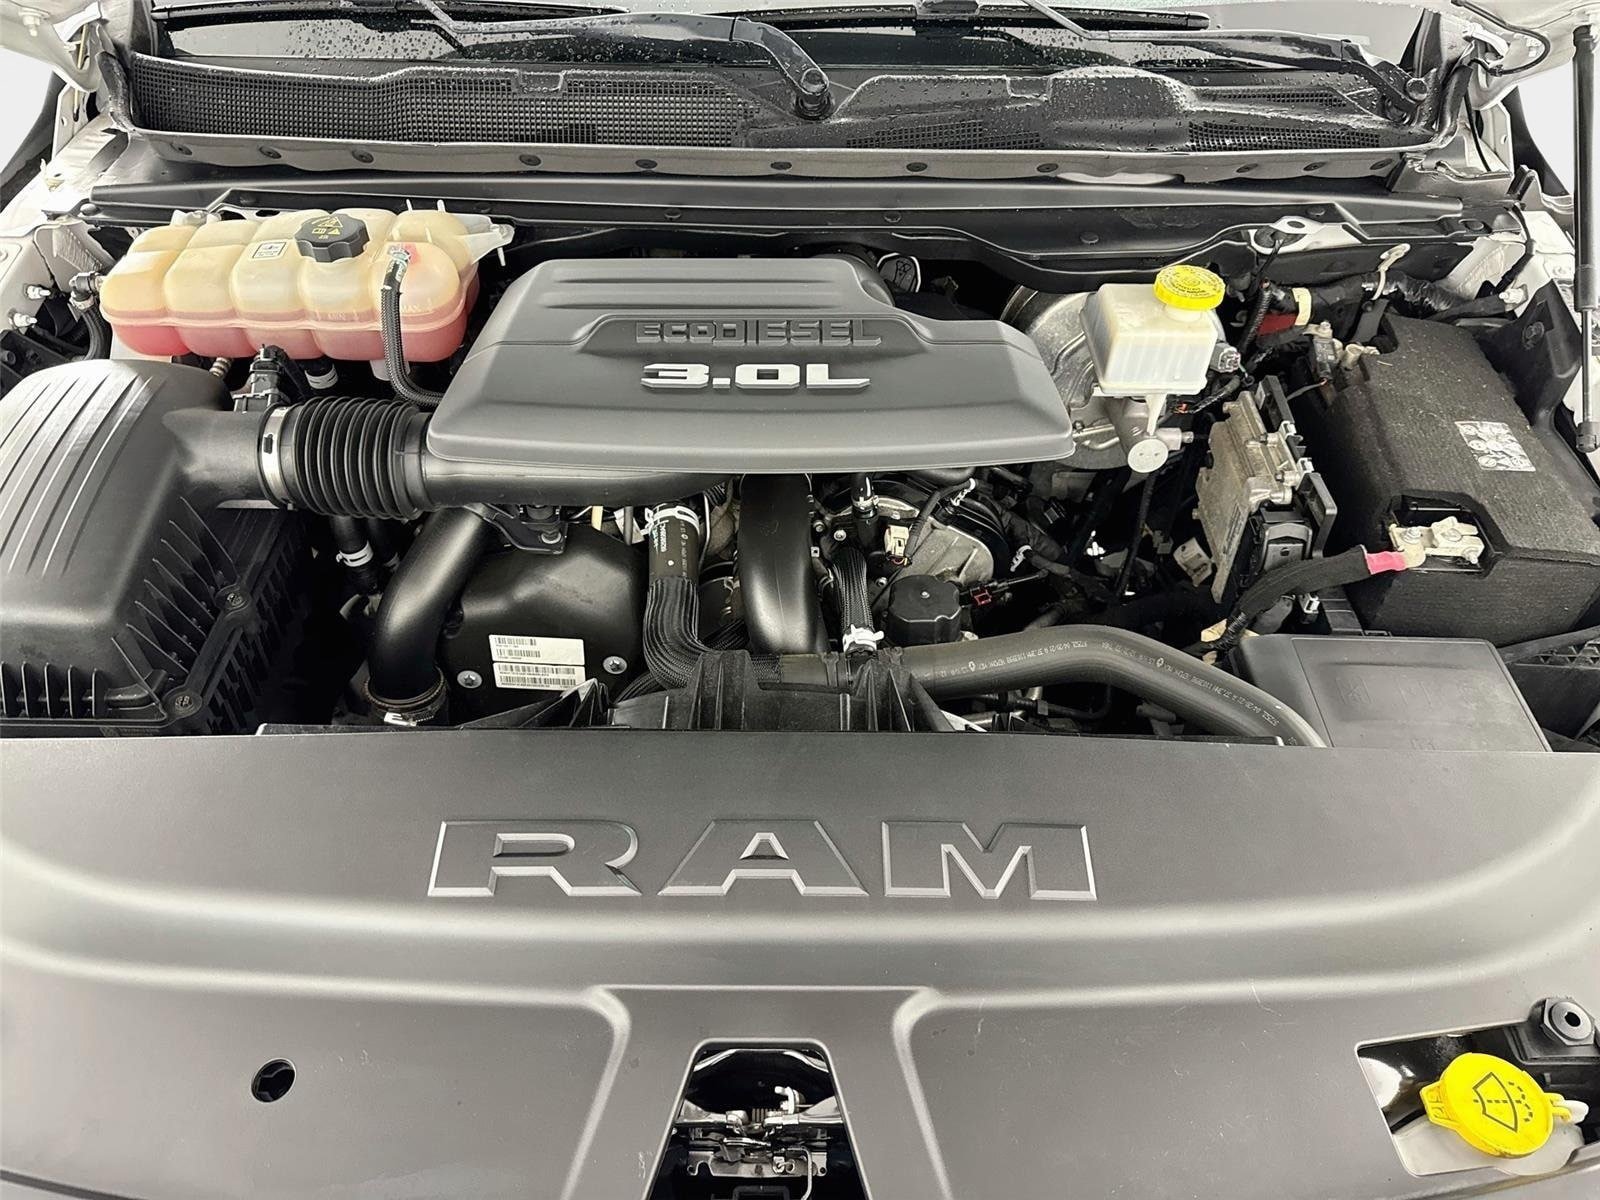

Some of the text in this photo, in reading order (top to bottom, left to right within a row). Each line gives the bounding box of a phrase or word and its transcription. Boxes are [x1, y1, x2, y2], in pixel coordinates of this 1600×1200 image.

[636, 320, 882, 346] ECODIESEL
[641, 363, 871, 390] 3.0L
[427, 818, 1098, 900] RAM
